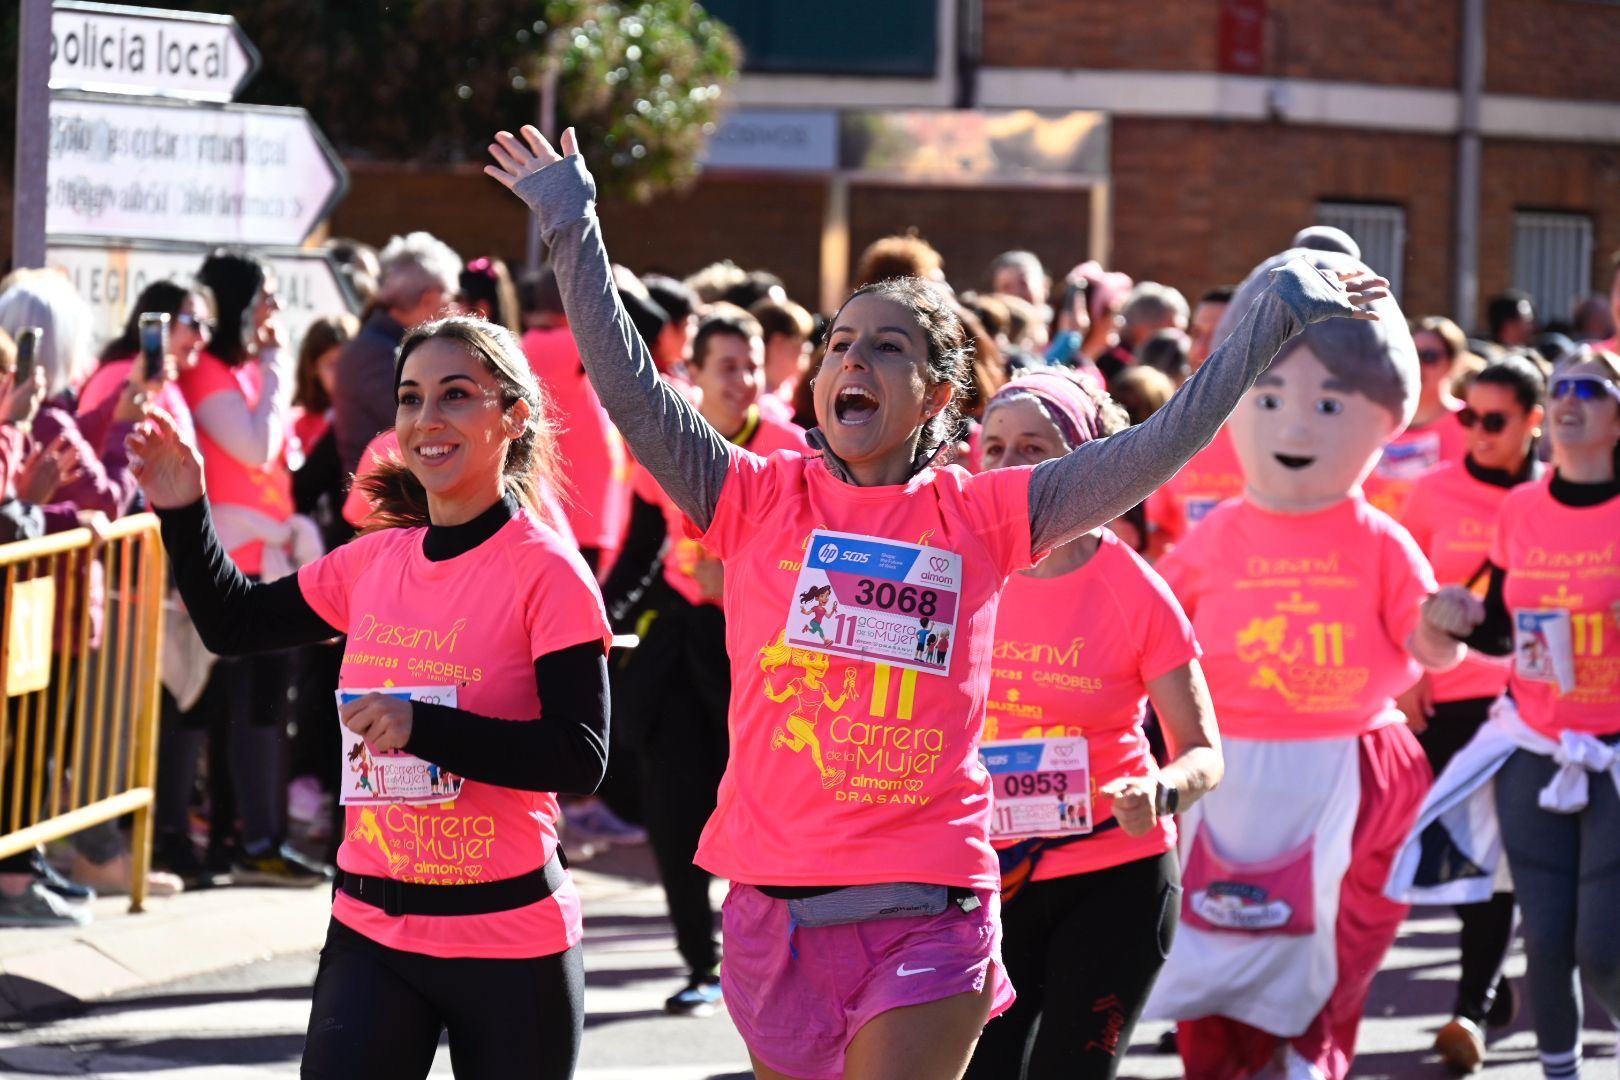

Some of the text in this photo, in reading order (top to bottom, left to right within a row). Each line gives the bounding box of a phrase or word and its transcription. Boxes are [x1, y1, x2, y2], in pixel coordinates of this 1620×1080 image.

[158, 29, 230, 79] local
[819, 543, 838, 564] hp
[921, 572, 953, 585] almom
[855, 579, 938, 617] 3068
[874, 630, 915, 645] Mujer
[993, 637, 1085, 668] asanvi
[407, 657, 482, 681] CAROBELS
[1033, 671, 1102, 689] CAROBELS
[830, 715, 943, 752] Carrera
[826, 746, 940, 779] de la Mujer
[850, 774, 902, 790] almom
[1004, 772, 1068, 796] 0953
[835, 791, 930, 806] DRASANV
[385, 804, 495, 838] Carrera
[415, 836, 496, 865] Mujer
[414, 861, 463, 876] almom
